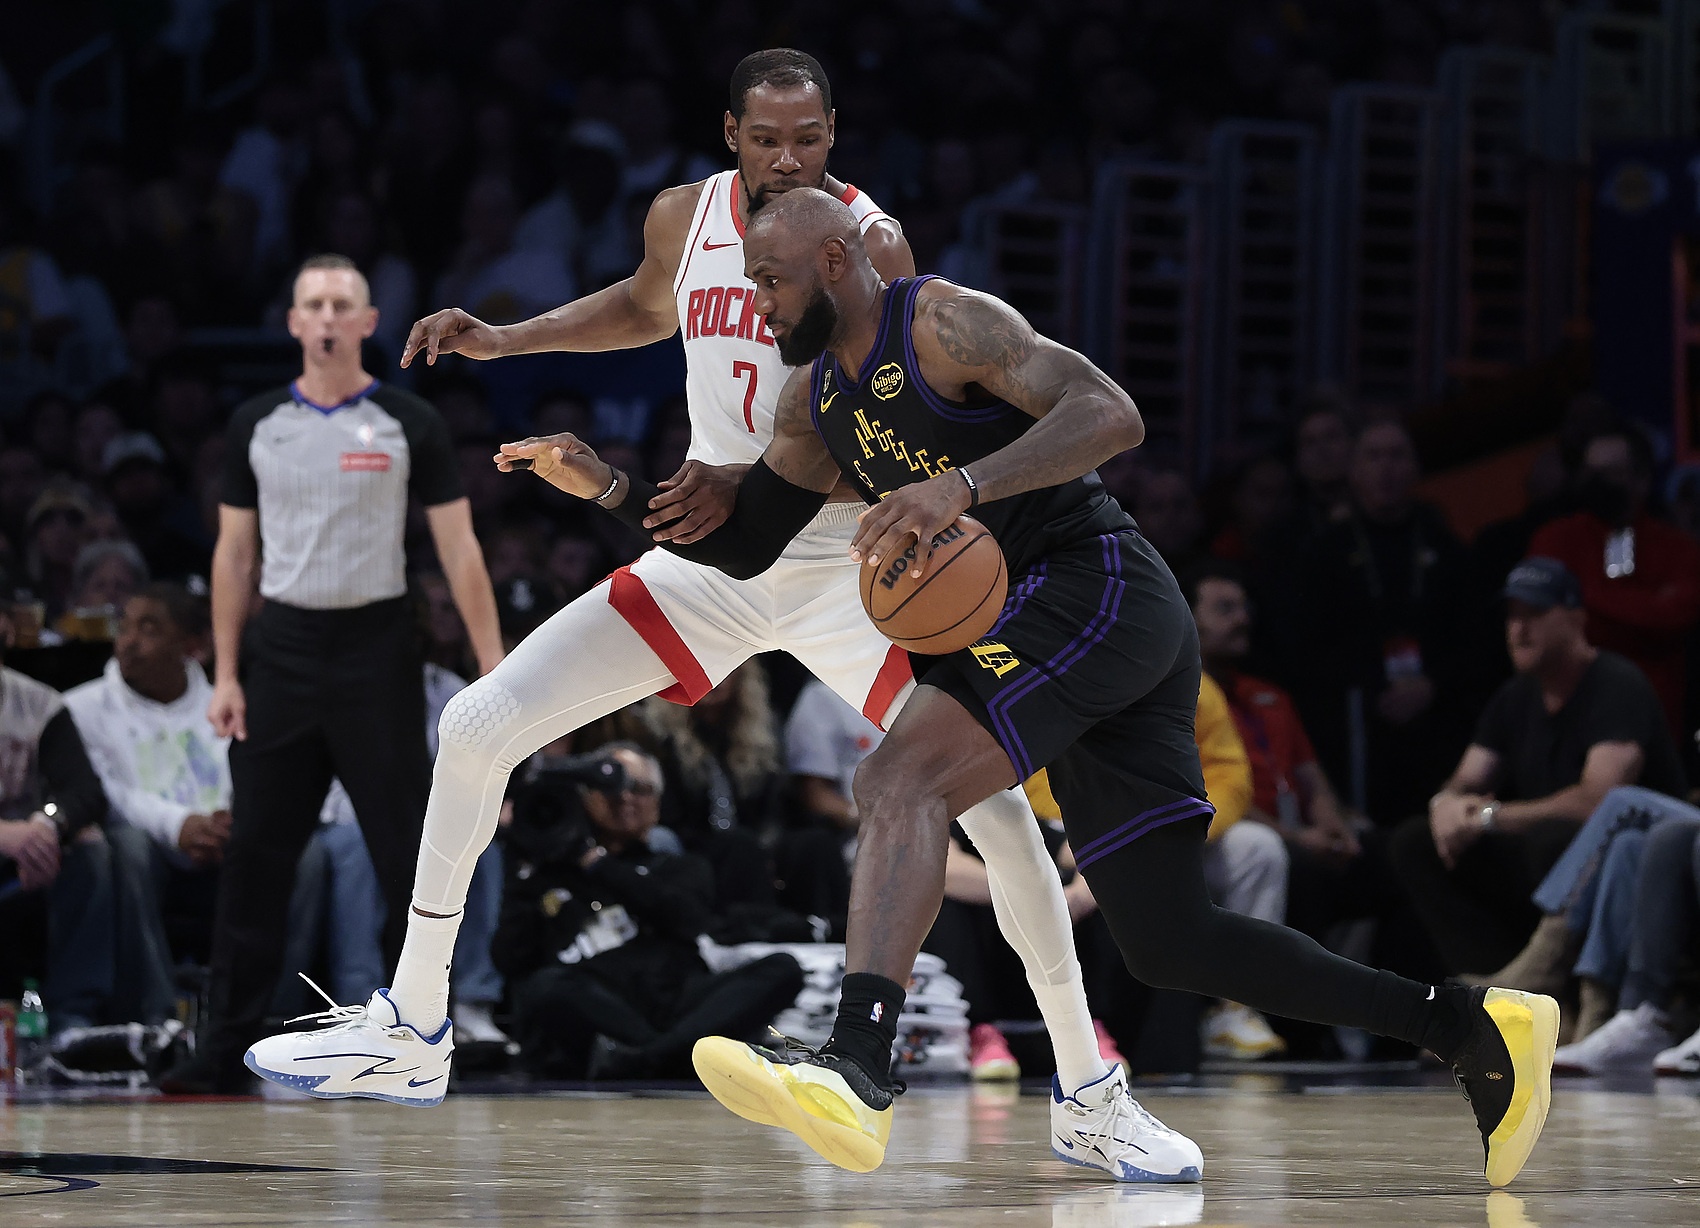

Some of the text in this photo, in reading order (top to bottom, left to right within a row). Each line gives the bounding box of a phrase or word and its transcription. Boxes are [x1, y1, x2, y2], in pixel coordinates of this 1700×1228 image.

[733, 361, 758, 433] 7
[874, 371, 901, 390] bibigo
[879, 523, 966, 590] Wson
